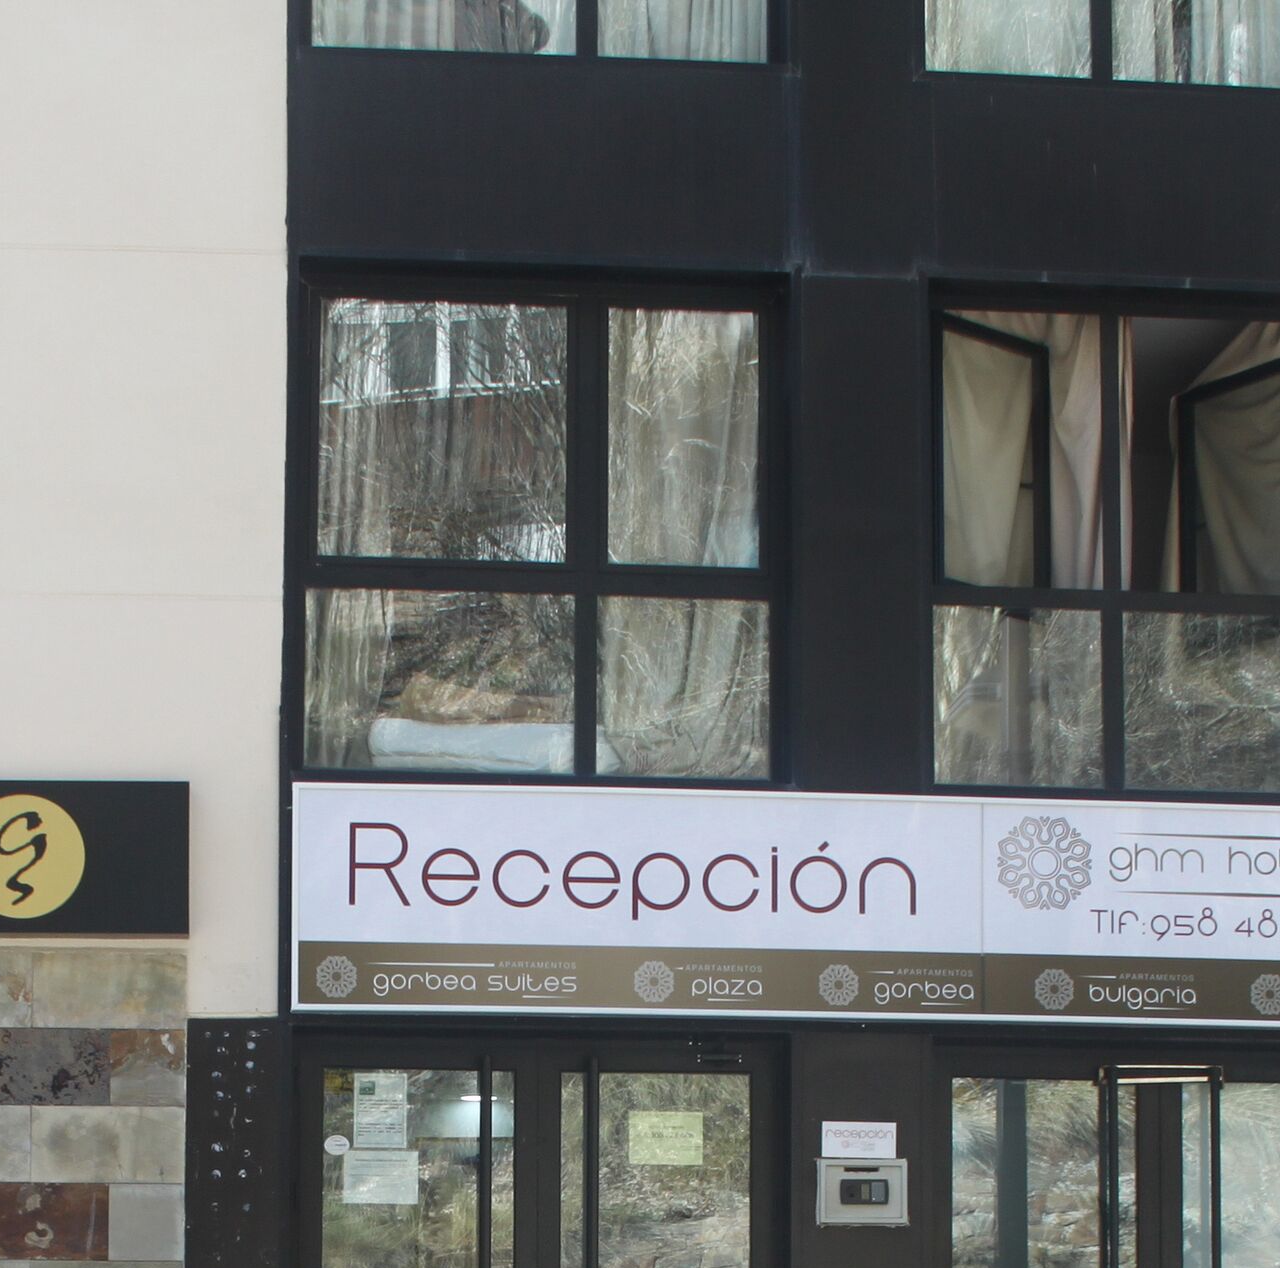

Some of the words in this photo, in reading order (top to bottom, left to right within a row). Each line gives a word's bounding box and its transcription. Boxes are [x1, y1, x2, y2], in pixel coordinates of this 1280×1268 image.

[348, 821, 918, 921] Recepción
[1108, 842, 1205, 882] ghm
[1234, 908, 1278, 939] 48
[498, 960, 577, 970] APARTAMENTOS
[685, 963, 763, 974] APARTAMENTOS
[896, 967, 974, 978] APARTAMENTOS
[372, 970, 476, 997] gorbea
[487, 971, 578, 993] suites
[691, 974, 763, 997] plaza
[1119, 973, 1195, 983] APARTAMENTOS
[874, 980, 975, 1005] gorbea
[1088, 984, 1197, 1010] bulgaria
